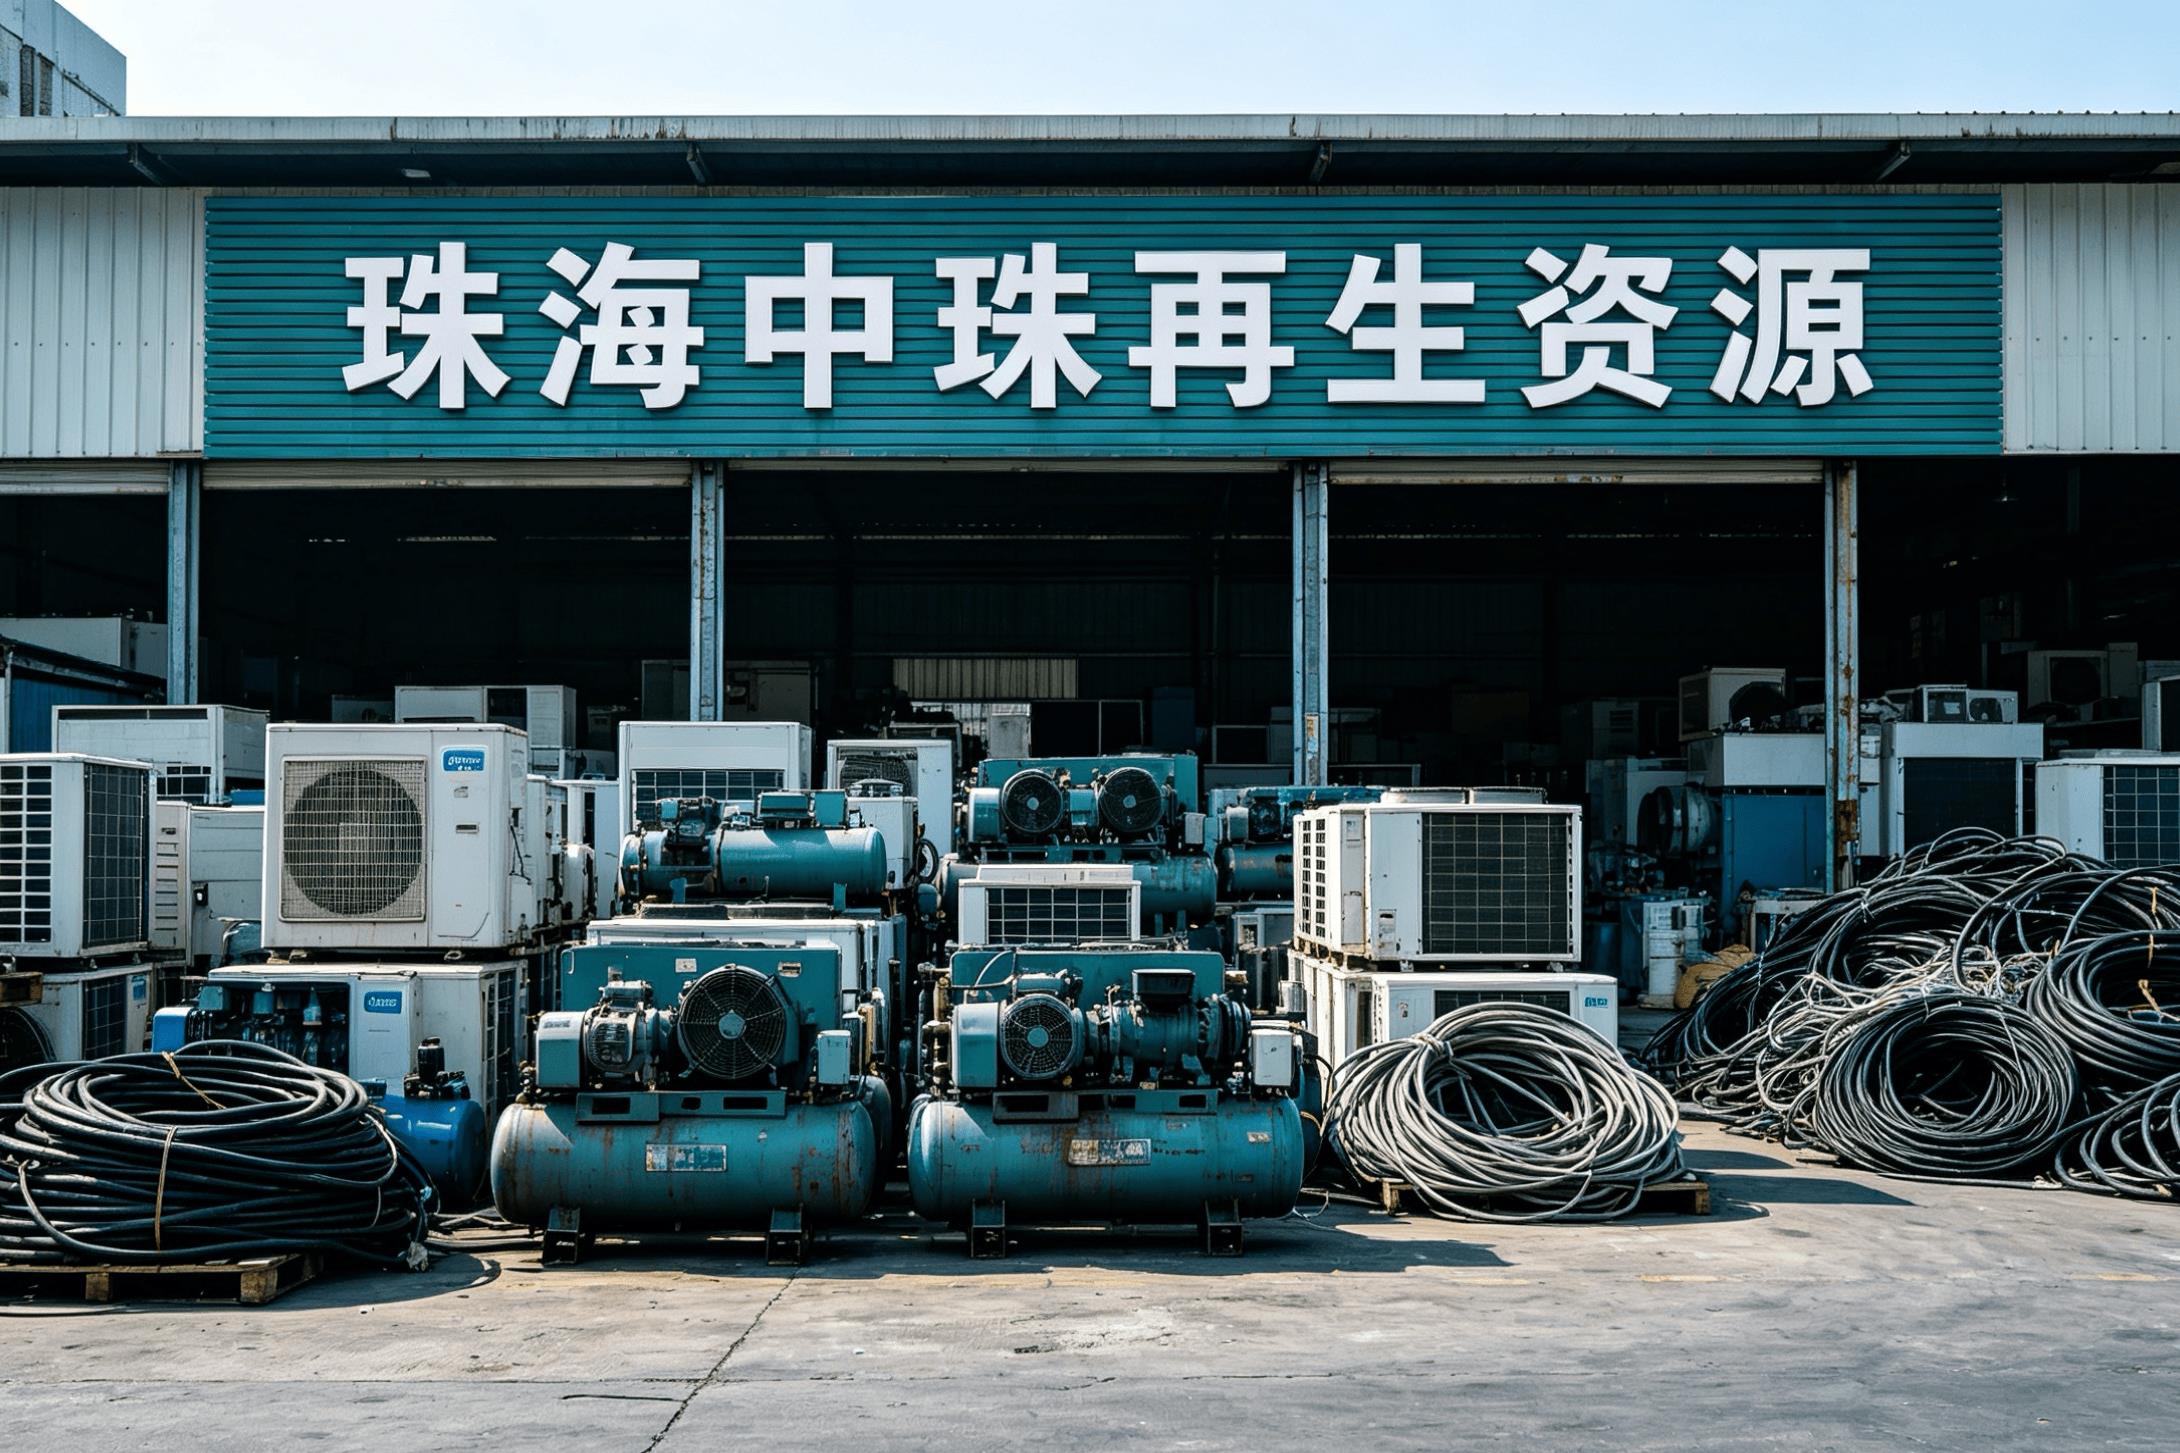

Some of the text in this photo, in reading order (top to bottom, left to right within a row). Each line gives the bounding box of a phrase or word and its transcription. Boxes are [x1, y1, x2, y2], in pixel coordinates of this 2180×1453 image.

[341, 241, 1875, 410] 珠海中珠再生资源
